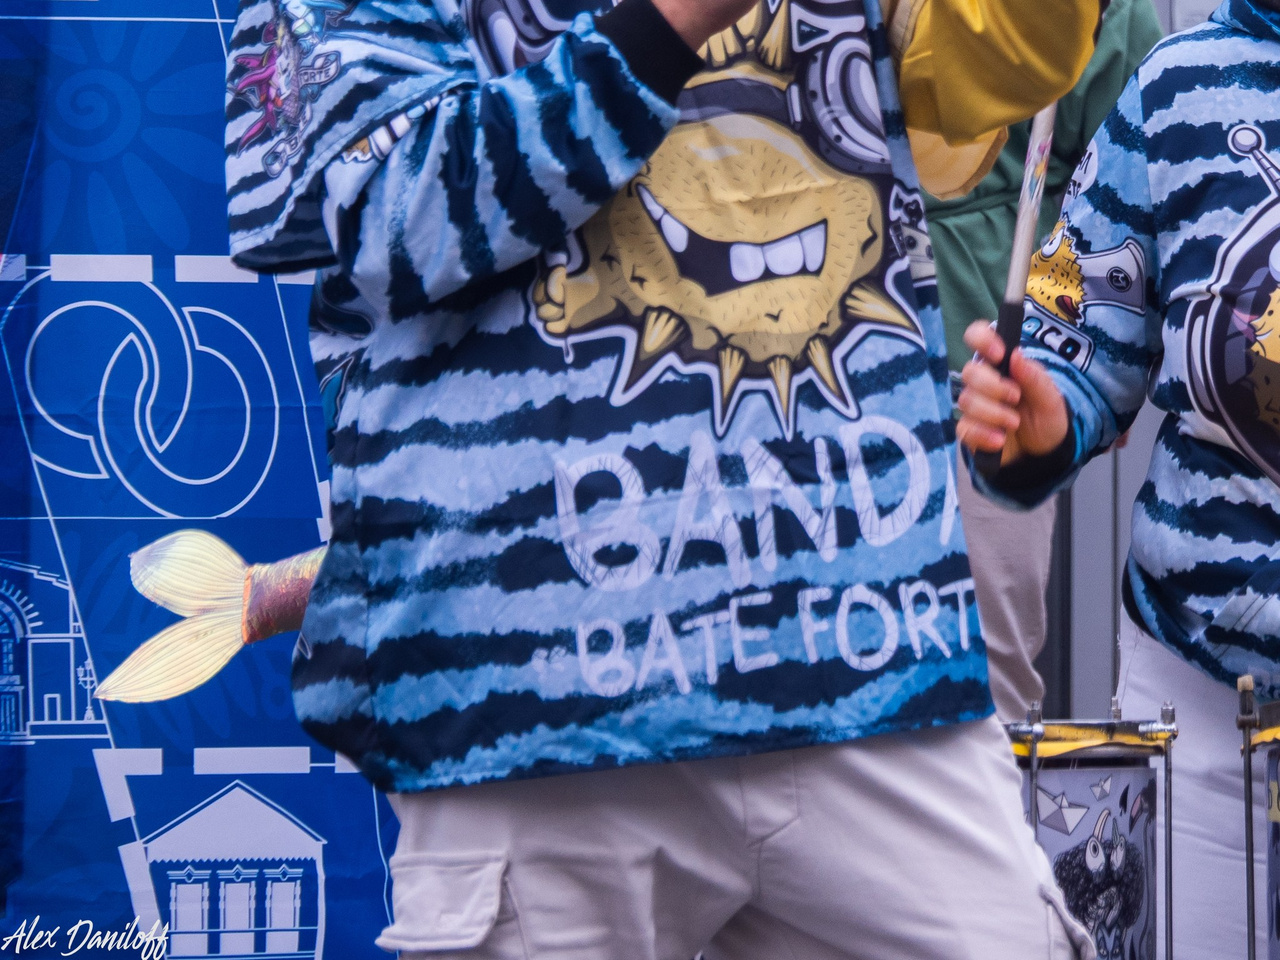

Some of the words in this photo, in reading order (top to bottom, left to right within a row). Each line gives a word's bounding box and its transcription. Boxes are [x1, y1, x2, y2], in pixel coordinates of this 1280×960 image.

[301, 68, 331, 81] ORTE
[1021, 316, 1081, 362] OCO
[576, 592, 779, 697] BATE
[796, 578, 976, 672] FORT
